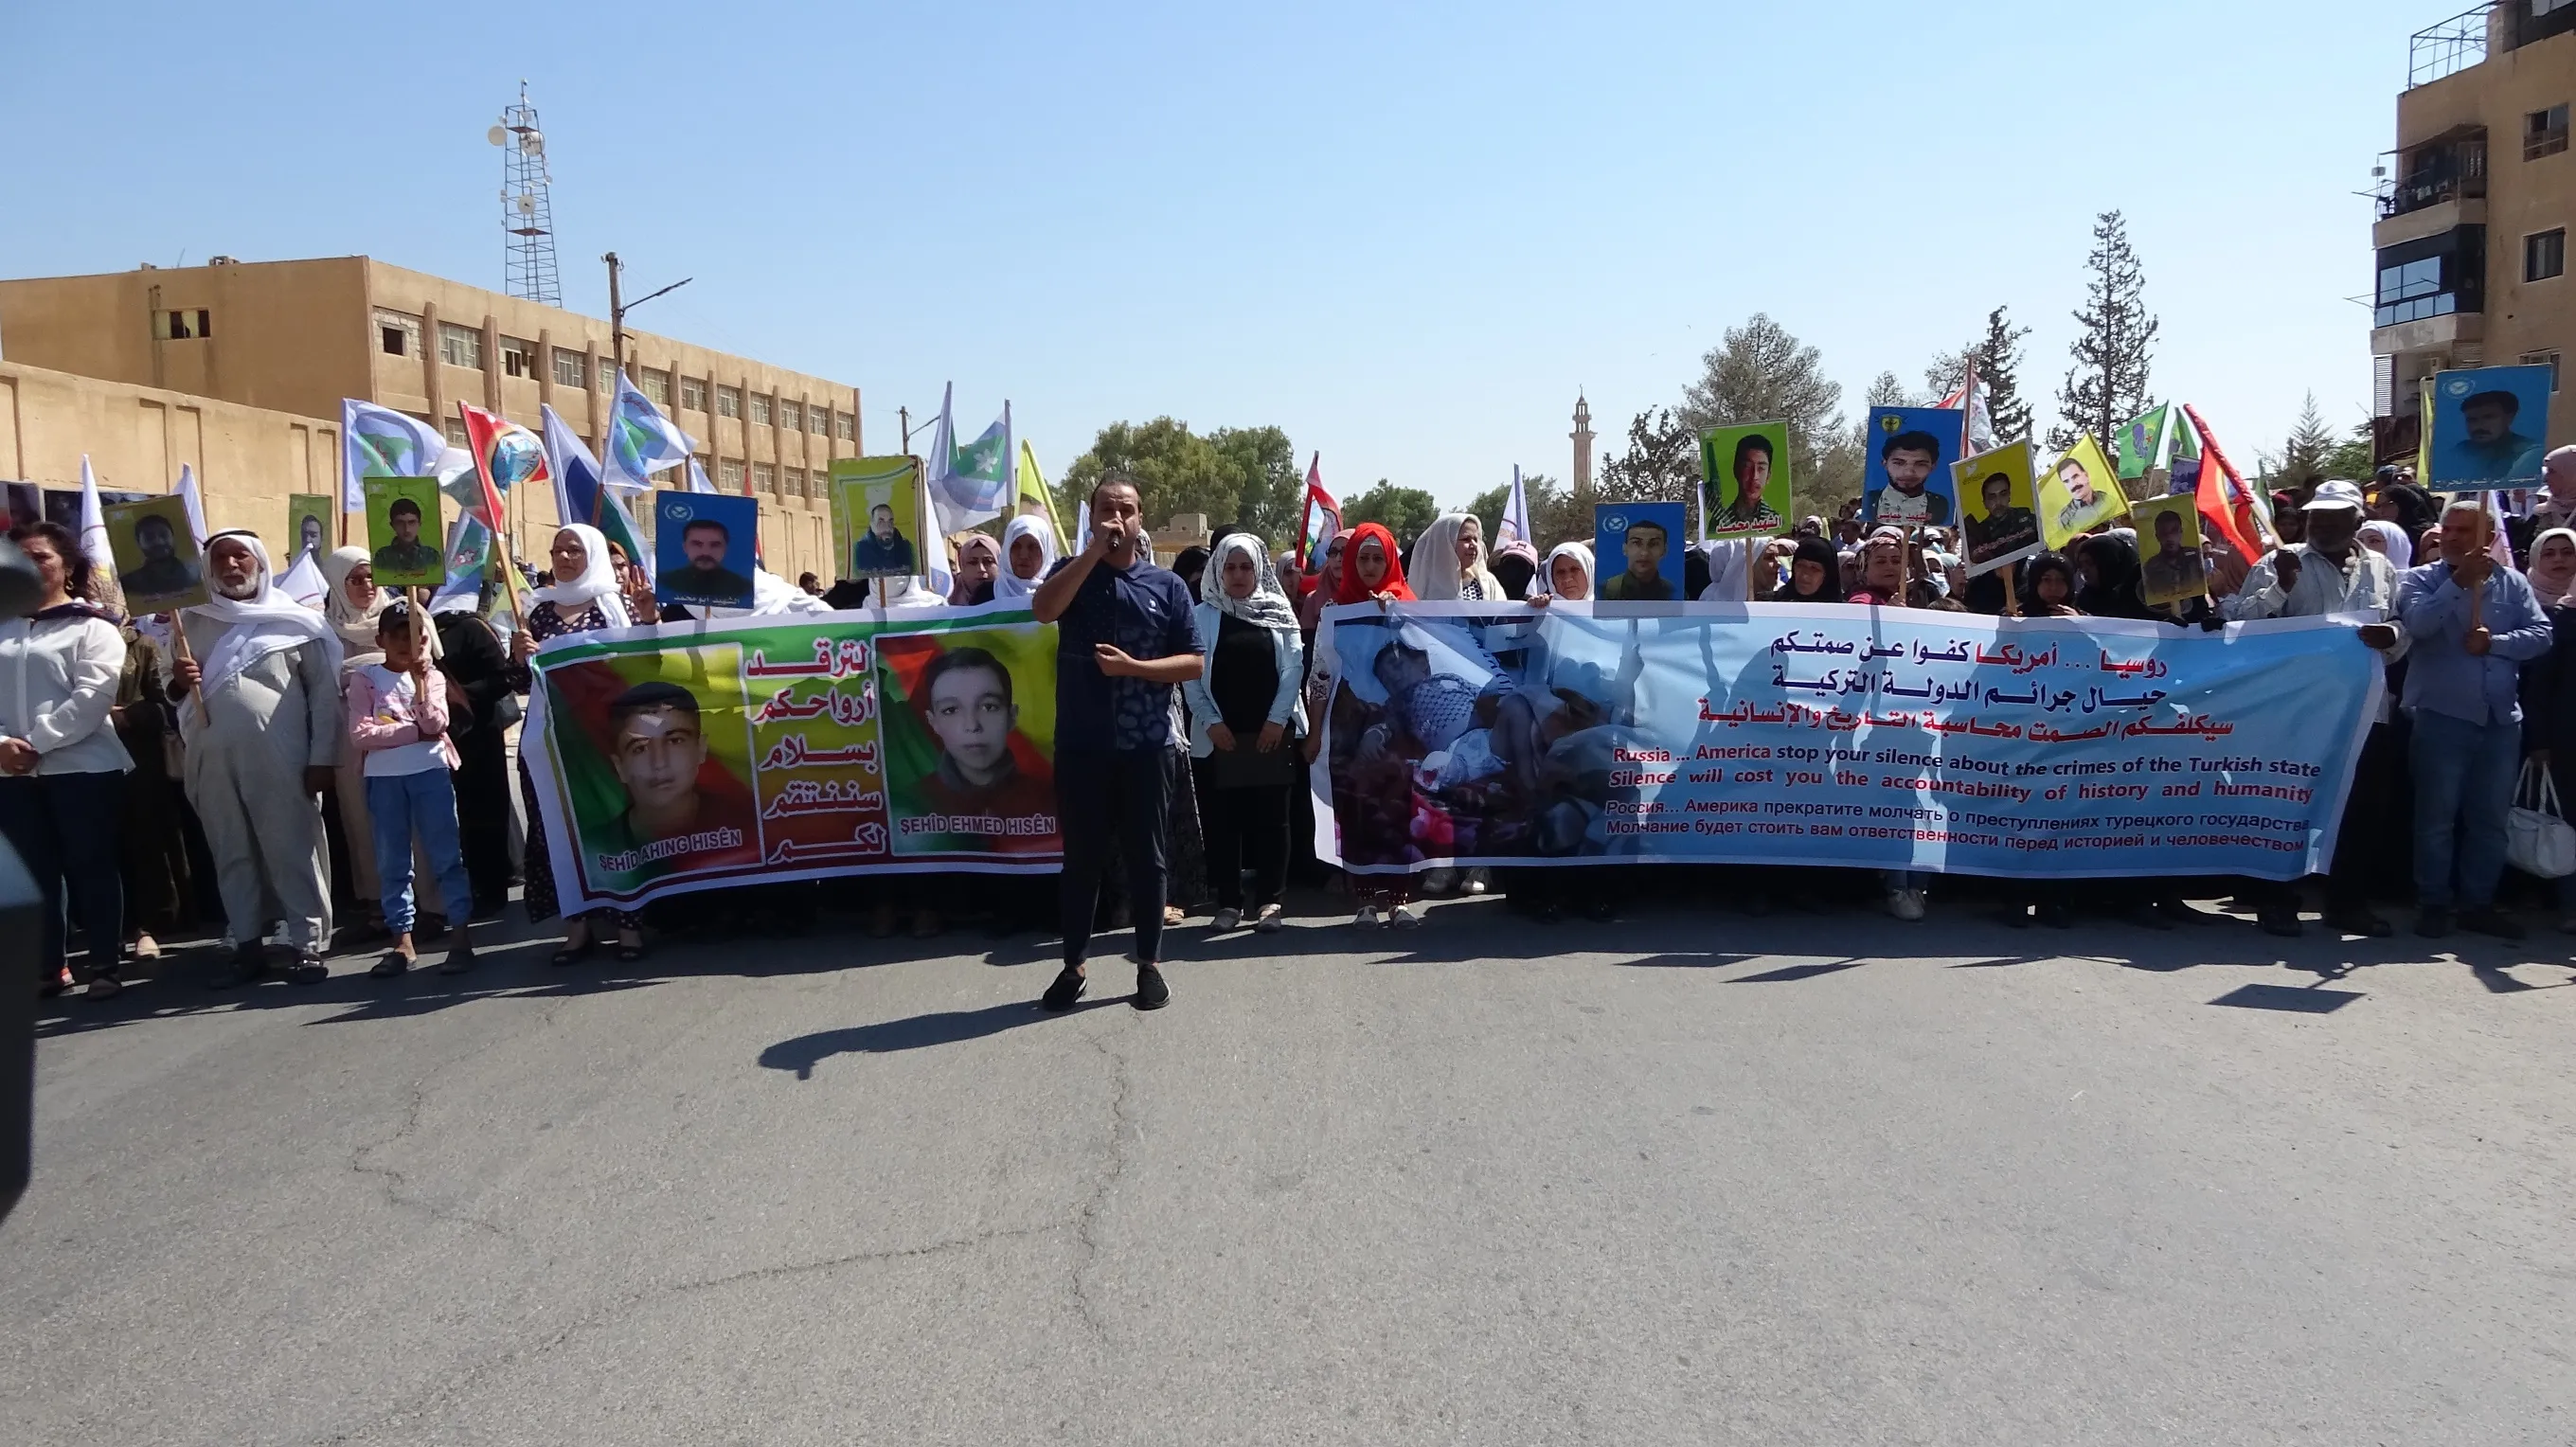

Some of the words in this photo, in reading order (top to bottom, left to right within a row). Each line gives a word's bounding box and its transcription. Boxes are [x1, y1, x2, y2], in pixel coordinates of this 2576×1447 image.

[1716, 518, 1750, 533] محمد
[1750, 513, 1782, 533] الشهيد
[746, 638, 868, 678] لترقد
[1770, 630, 1854, 658] صمتكم
[1858, 634, 1905, 662] عن
[1912, 637, 1971, 666] كفوا
[1976, 641, 2057, 674] أمريكا
[1771, 664, 1876, 697] التركية
[2100, 649, 2168, 680] روسيا
[754, 682, 875, 724] أرواحكم
[1882, 670, 1980, 706] الدولة
[1984, 682, 2077, 714] جرائم
[2082, 686, 2168, 714] حيال
[1696, 697, 1822, 730] والإنسانية
[1825, 706, 1917, 732] التاريخ
[1922, 711, 2023, 740] محاسبة
[2027, 717, 2120, 742] الصمت
[2121, 713, 2235, 742] سيكلفكم
[760, 736, 877, 773] بسلام
[1613, 746, 1671, 763] Russia
[1695, 742, 1771, 760] America
[1776, 744, 1819, 763] stop
[1824, 747, 1870, 764] your
[1874, 748, 1943, 768] silence
[1948, 755, 2009, 777] about
[2014, 761, 2048, 777] the
[2052, 759, 2117, 777] crimes
[2121, 756, 2144, 774] of
[2149, 757, 2182, 773] the
[2189, 757, 2263, 773] Turkish
[2268, 759, 2321, 777] state
[764, 781, 882, 818] سننتقم
[1609, 769, 1677, 787] Silence
[1689, 768, 1723, 784] will
[1734, 768, 1774, 784] cost
[1785, 770, 1822, 787] you
[1835, 769, 1869, 786] the
[1881, 775, 2032, 803] accountability
[2044, 784, 2067, 801] of
[2078, 783, 2149, 801] history
[2161, 780, 2201, 797] and
[2213, 780, 2315, 805] humanity
[901, 813, 946, 835] ŞEHÎD
[951, 816, 1004, 834] EHMED
[1007, 813, 1056, 834] HISÊN
[1684, 798, 1759, 814] Америка
[1763, 803, 1864, 817] прекратите
[1869, 806, 1943, 822] молчать
[1948, 812, 1960, 823] о
[1965, 813, 2099, 832] преступлениях
[2104, 813, 2194, 831] турецкого
[2199, 813, 2310, 832] государства
[599, 850, 640, 872] ŞEHÎD
[641, 837, 689, 864] AHING
[691, 827, 742, 851] HISÊN
[768, 824, 885, 864] لكم
[1605, 819, 1690, 834] Молчание
[1694, 818, 1744, 837] будет
[1747, 821, 1804, 835] стоить
[1810, 824, 1843, 836] вам
[1848, 827, 1999, 847] ответственности
[2004, 836, 2059, 852] перед
[2064, 832, 2145, 850] историей
[2150, 834, 2161, 847] и
[2166, 832, 2305, 853] человечеством
